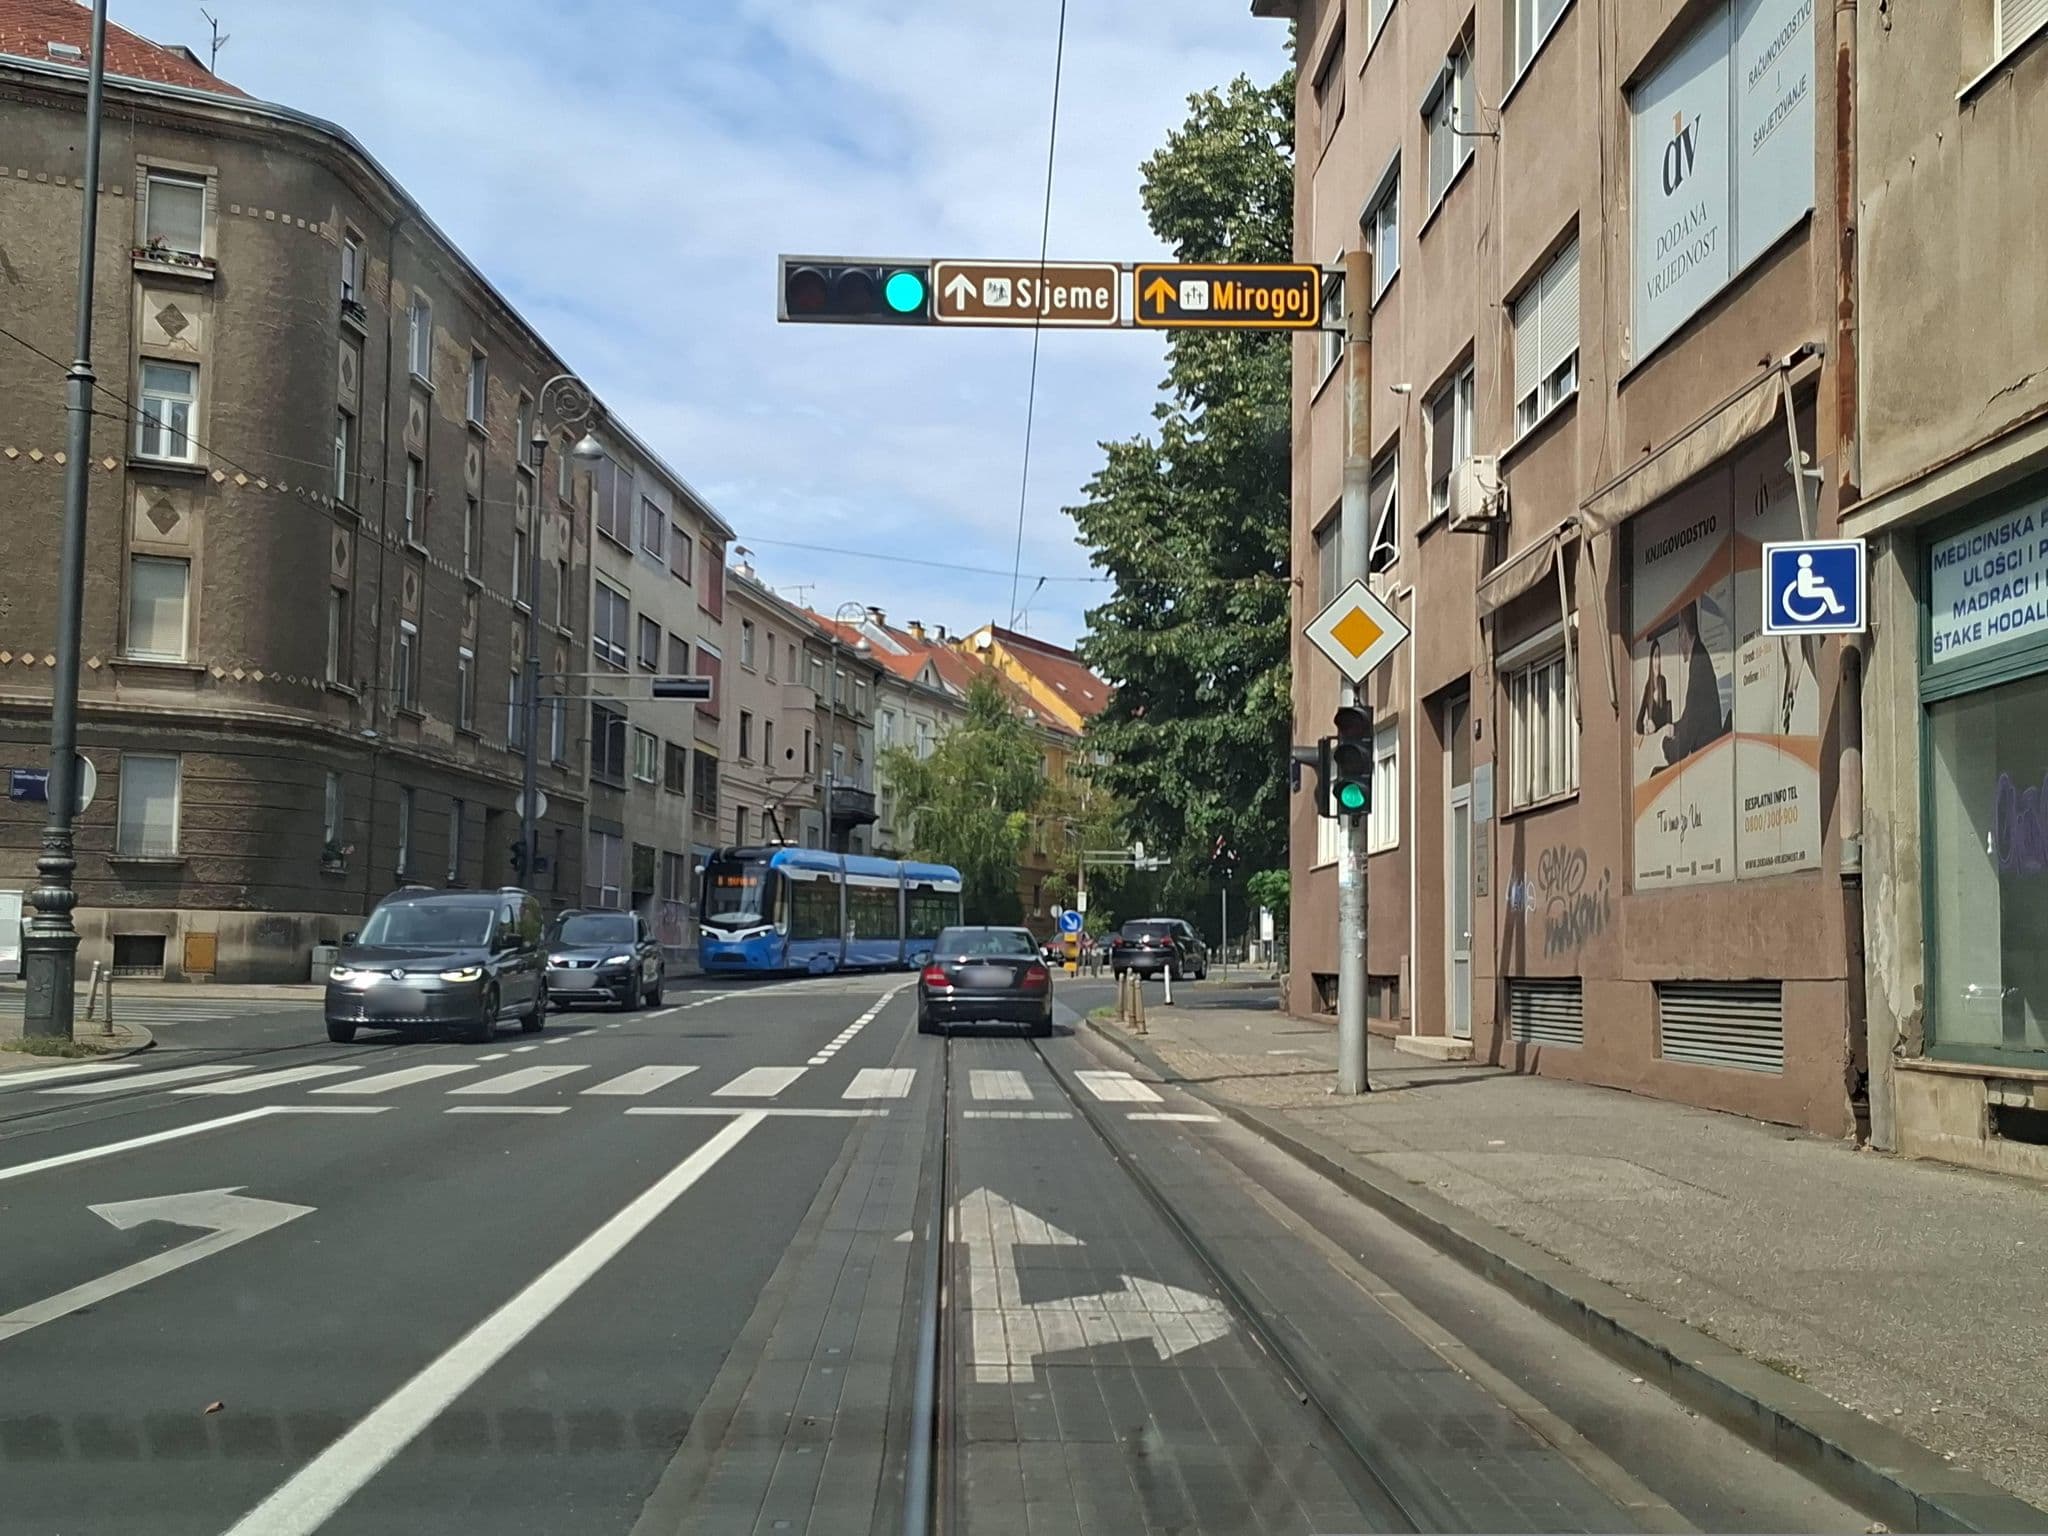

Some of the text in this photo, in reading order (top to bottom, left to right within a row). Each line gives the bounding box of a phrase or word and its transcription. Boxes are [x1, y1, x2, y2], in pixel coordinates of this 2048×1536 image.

[1748, 0, 1812, 86] RAČUNOVODSTVO
[1752, 73, 1807, 148] SAVJETOVANJE
[1656, 200, 1708, 261] DODANA
[1646, 226, 1718, 302] VRIJEDNOST
[1016, 277, 1109, 316] Sljeme
[1213, 281, 1309, 318] Mirogoj
[1645, 515, 1717, 565] KNJIGOVODSTVO
[1934, 515, 2034, 571] MEDICINSKA
[1963, 547, 2022, 587] ULOŠCI
[1953, 576, 2029, 620] MADRACI
[1933, 622, 1982, 653] ŠTAKE
